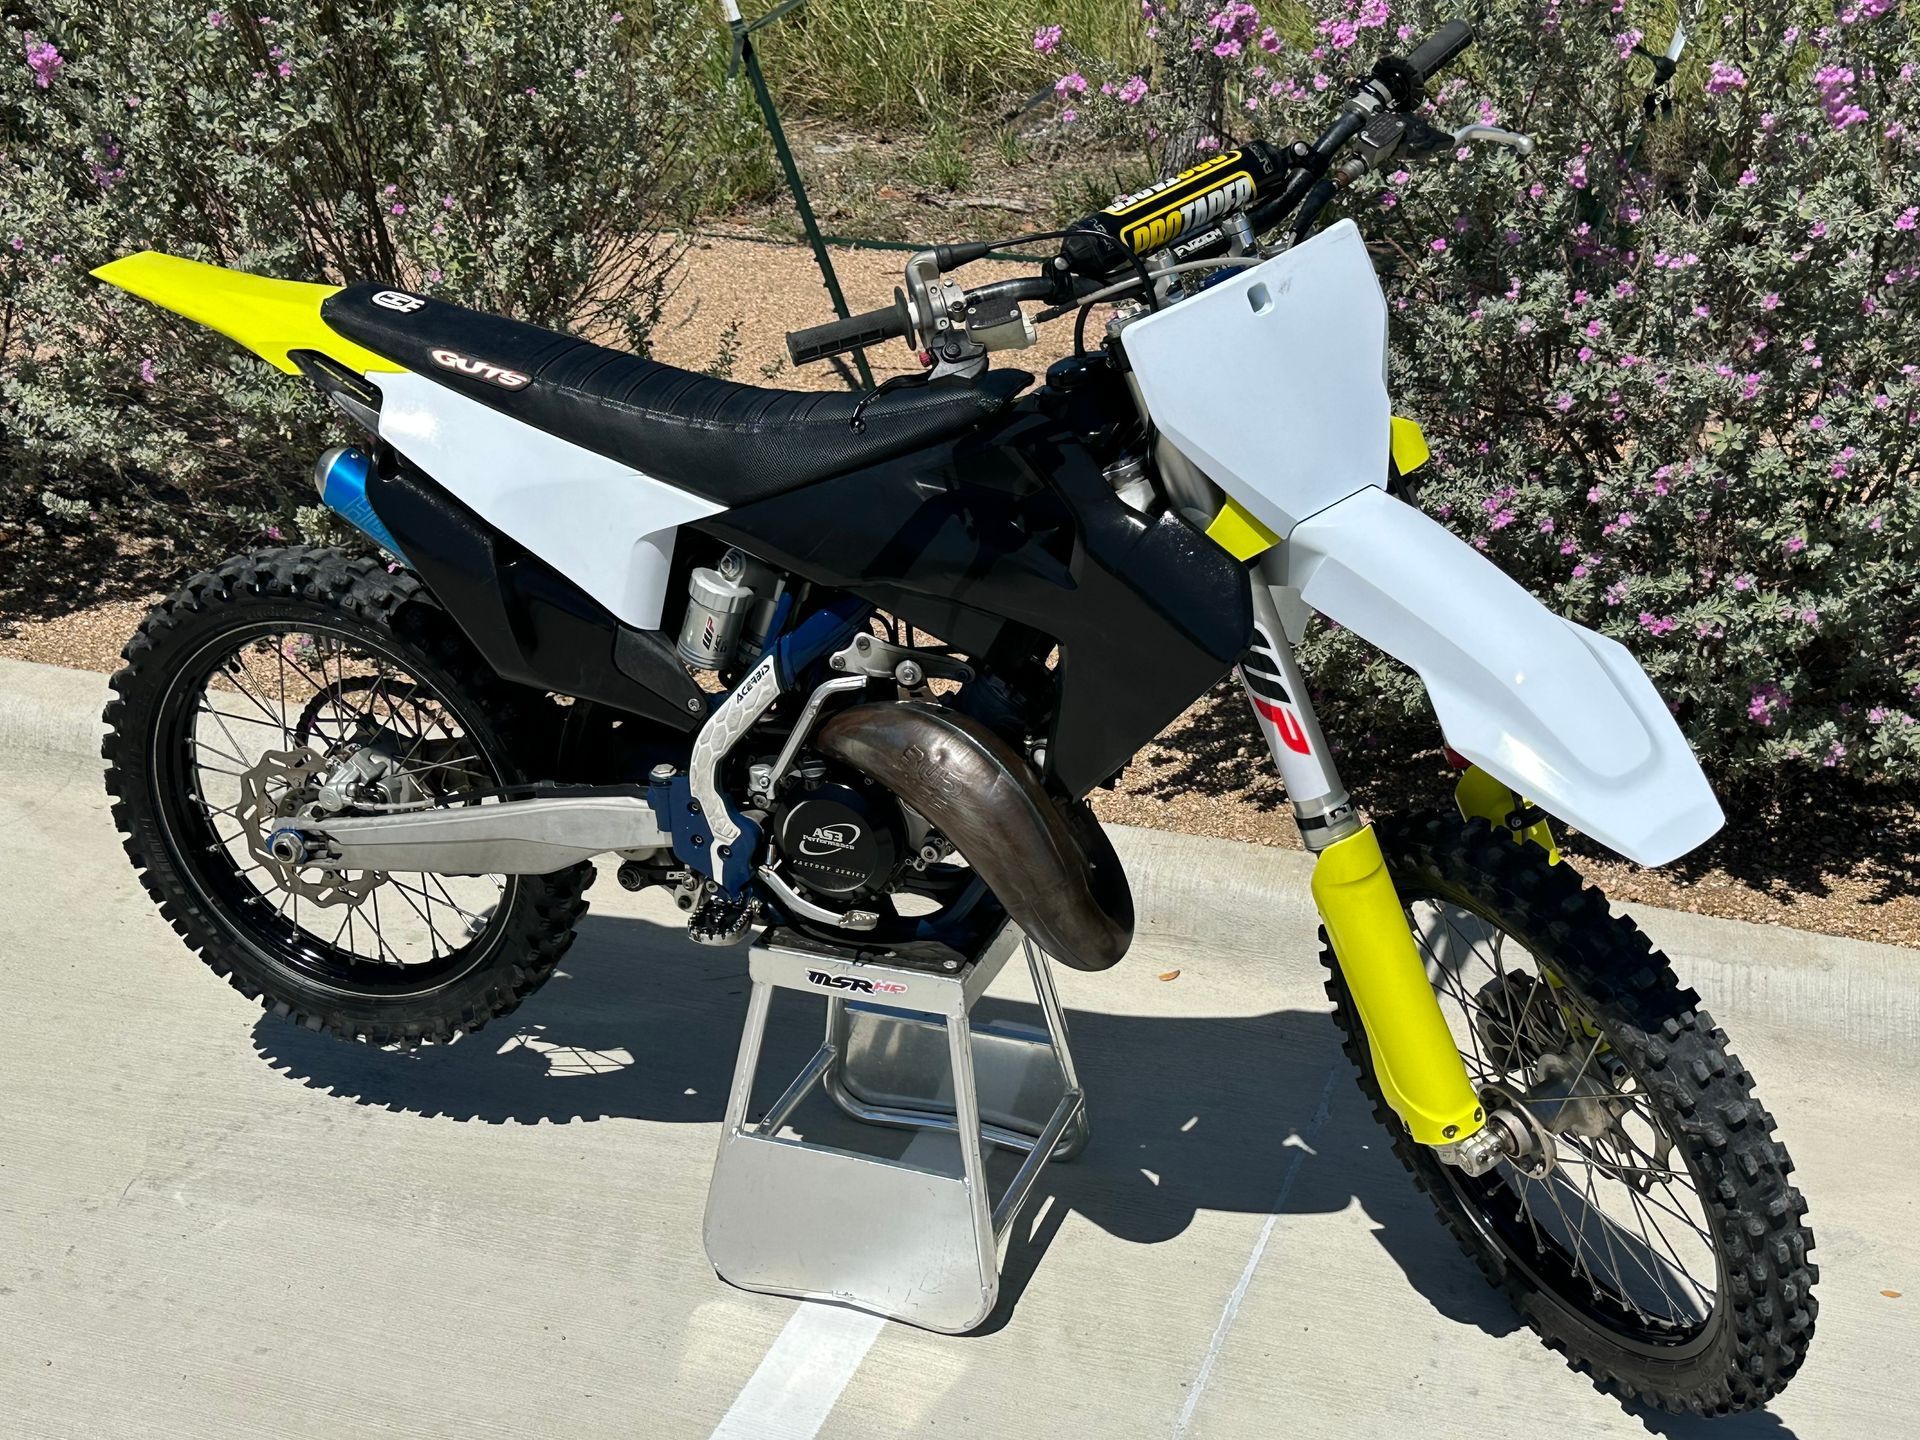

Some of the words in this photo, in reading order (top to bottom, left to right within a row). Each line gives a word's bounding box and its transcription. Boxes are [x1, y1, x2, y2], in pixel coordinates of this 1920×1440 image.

[431, 349, 528, 386] GUTS
[736, 664, 770, 704] ACERBIS
[802, 833, 855, 850] Performance
[812, 828, 843, 842] AS3
[793, 859, 831, 871] FACTORY
[835, 868, 866, 879] SERIES
